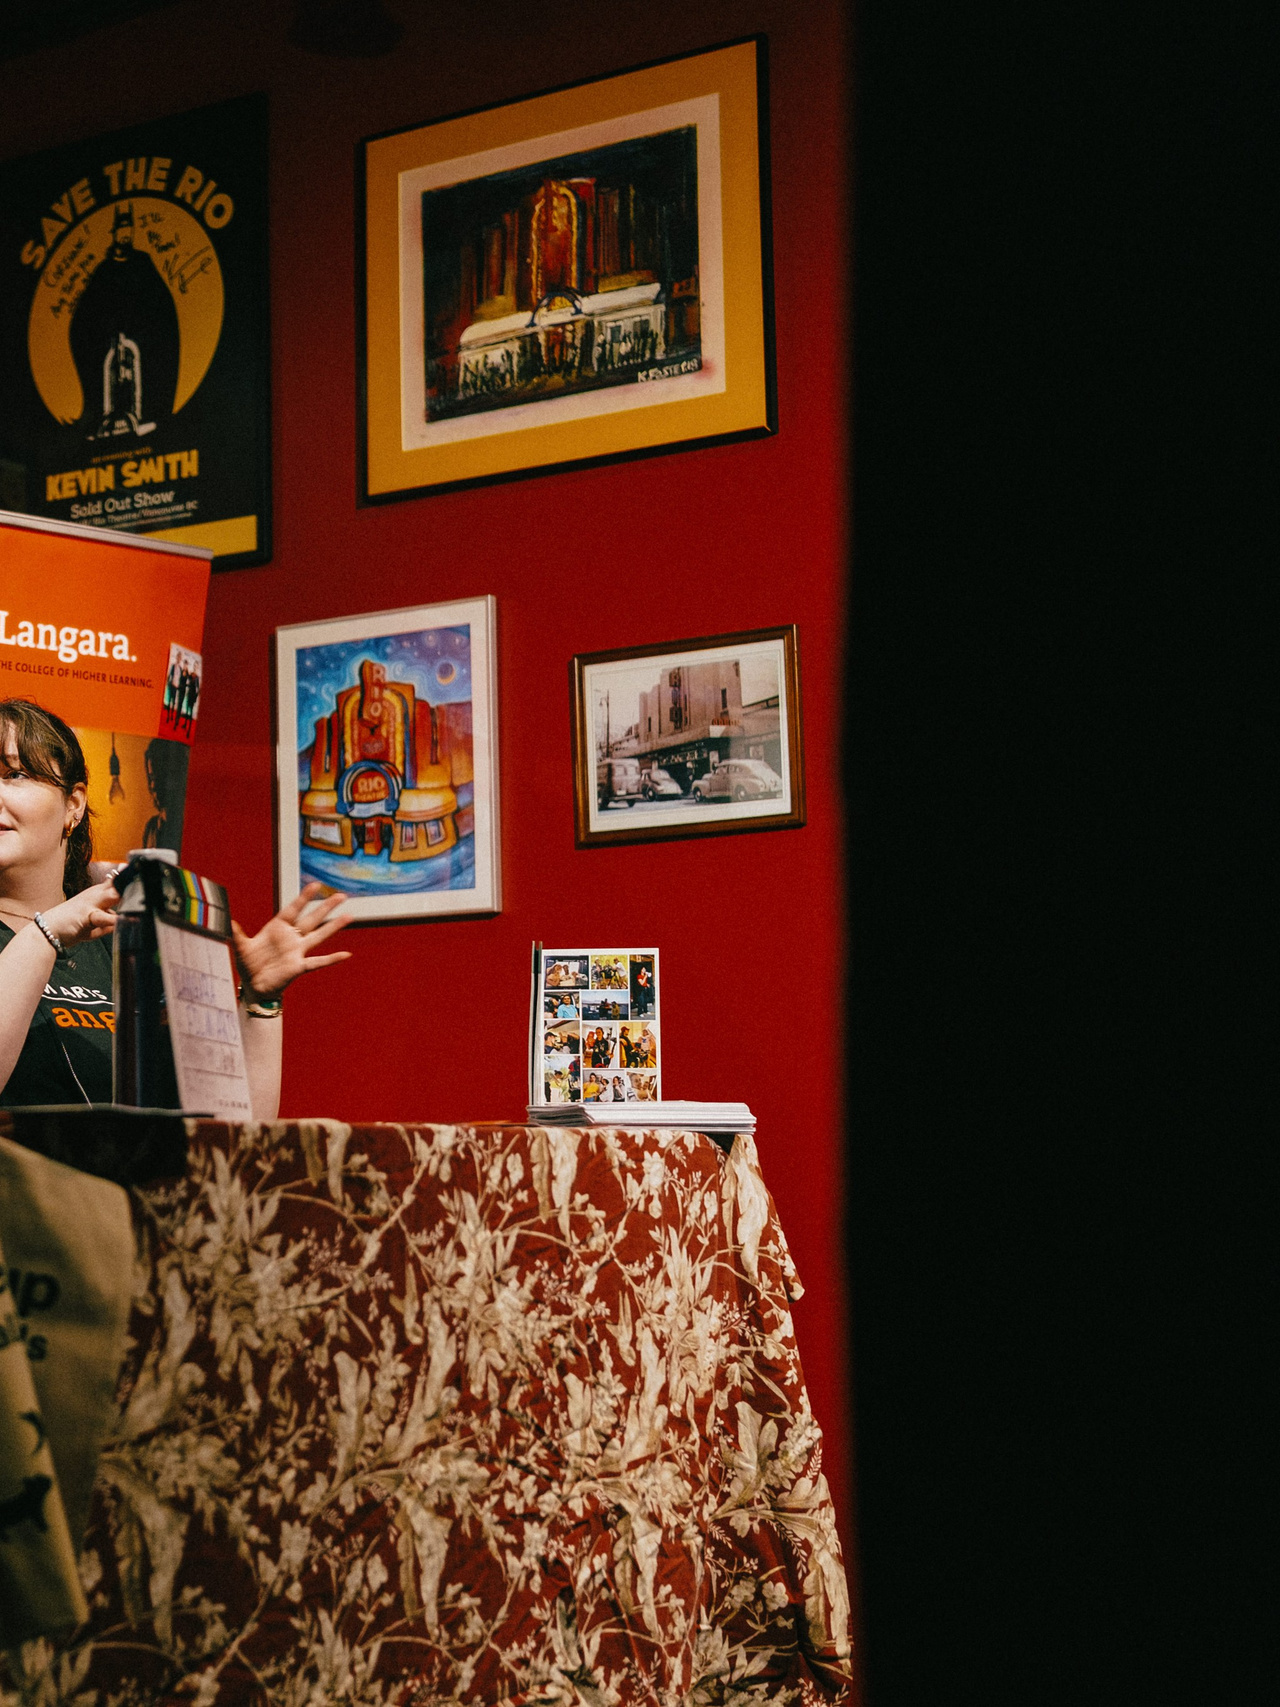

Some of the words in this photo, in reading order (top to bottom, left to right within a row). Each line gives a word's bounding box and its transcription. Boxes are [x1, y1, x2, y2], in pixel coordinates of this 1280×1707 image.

[21, 178, 96, 270] SAVE
[103, 156, 172, 196] THE
[174, 165, 234, 230] RIO
[45, 464, 115, 502] KEVIN
[121, 449, 199, 489] SMITH
[70, 501, 103, 519] Sold
[104, 498, 131, 513] Out
[133, 491, 175, 508] Show
[15, 662, 54, 676] COLLEGE
[57, 668, 69, 677] OF
[72, 670, 106, 682] HIGHER
[109, 675, 154, 689] LEARNING.
[371, 663, 386, 717] RIO
[357, 776, 385, 793] RIO
